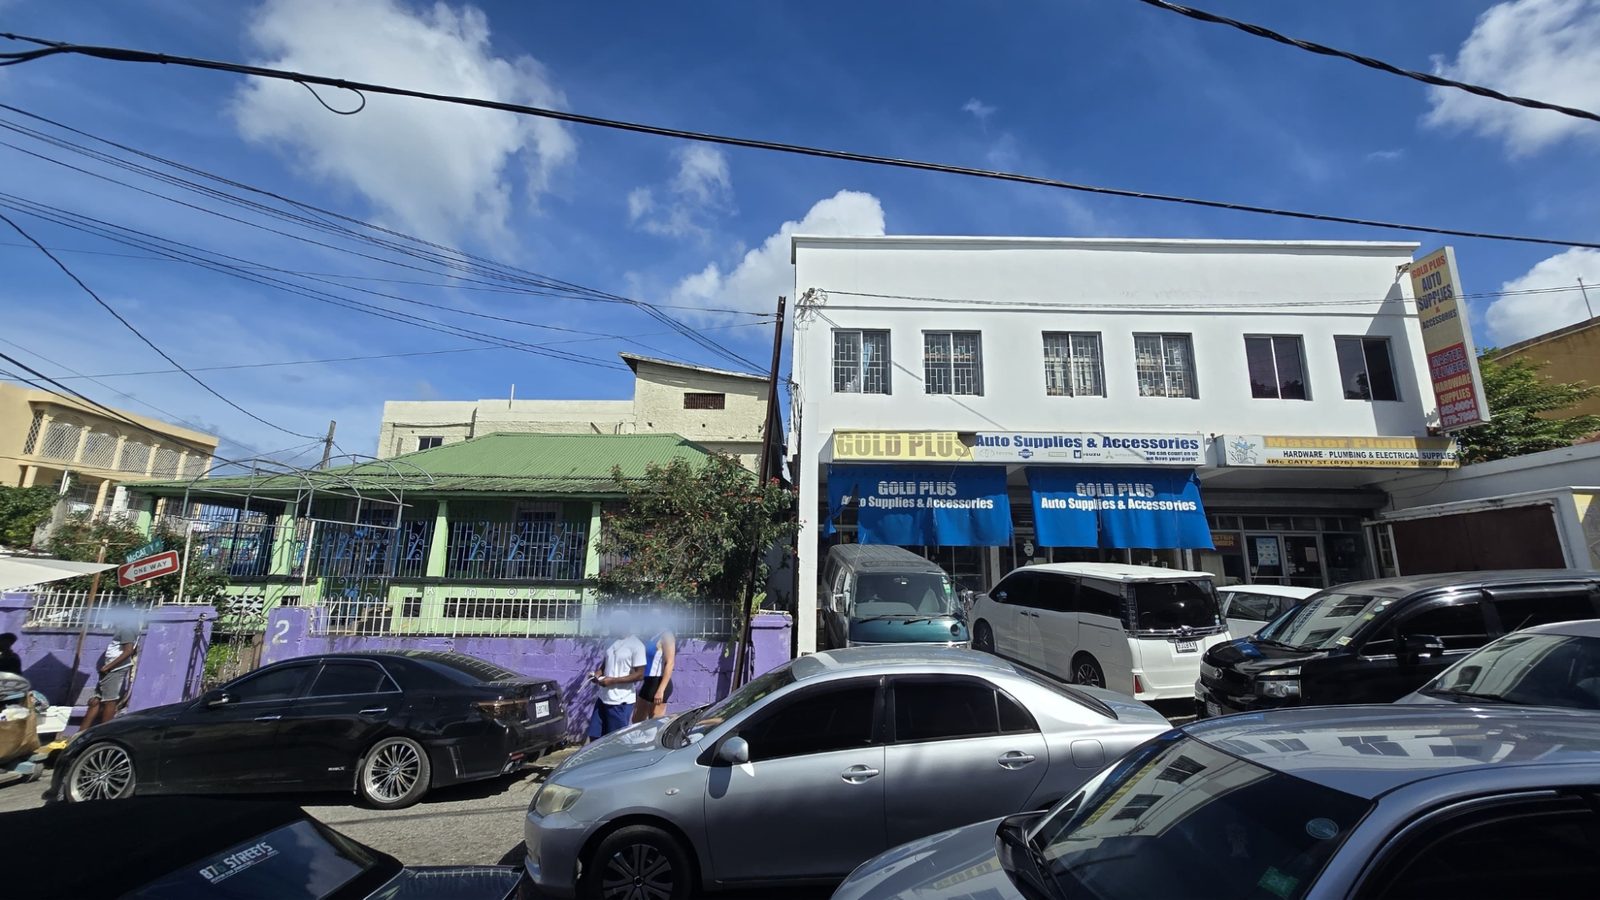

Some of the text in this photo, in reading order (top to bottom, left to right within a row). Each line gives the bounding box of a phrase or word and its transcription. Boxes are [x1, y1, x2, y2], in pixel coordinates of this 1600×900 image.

[1412, 255, 1445, 279] GOLD PLUS
[1422, 271, 1442, 292] AUTO
[1418, 284, 1453, 312] SUPPLIES
[1423, 308, 1457, 329] ACCESSORIES
[1431, 348, 1463, 368] MASTER
[1432, 360, 1468, 380] PLUMBER
[1434, 373, 1472, 393] HARDWARE
[1440, 387, 1471, 405] SUPPLIES
[837, 433, 970, 458] GOLD PLUS
[975, 434, 1200, 450] Auto Supplies & Accessories
[1266, 437, 1346, 449] Master
[1283, 450, 1323, 459] HARDWARE
[1329, 451, 1367, 459] PLUMBING
[1376, 452, 1419, 460] ELECTRICAL
[1422, 452, 1457, 460] SUPPLIES
[878, 481, 957, 496] GOLD PLUS
[1076, 483, 1155, 498] GOLD PLUS
[868, 496, 915, 508] Supplies
[917, 498, 924, 508] &
[926, 497, 994, 509] Accessories
[1041, 498, 1197, 511] Auto Supplies & Accessories
[134, 560, 167, 575] ONE WAY
[464, 587, 477, 596] m
[487, 588, 496, 597] n
[507, 587, 518, 597] o
[528, 586, 537, 598] p
[547, 587, 556, 599] q
[568, 588, 575, 598] r
[272, 620, 290, 643] 2
[223, 842, 273, 869] STREETS
